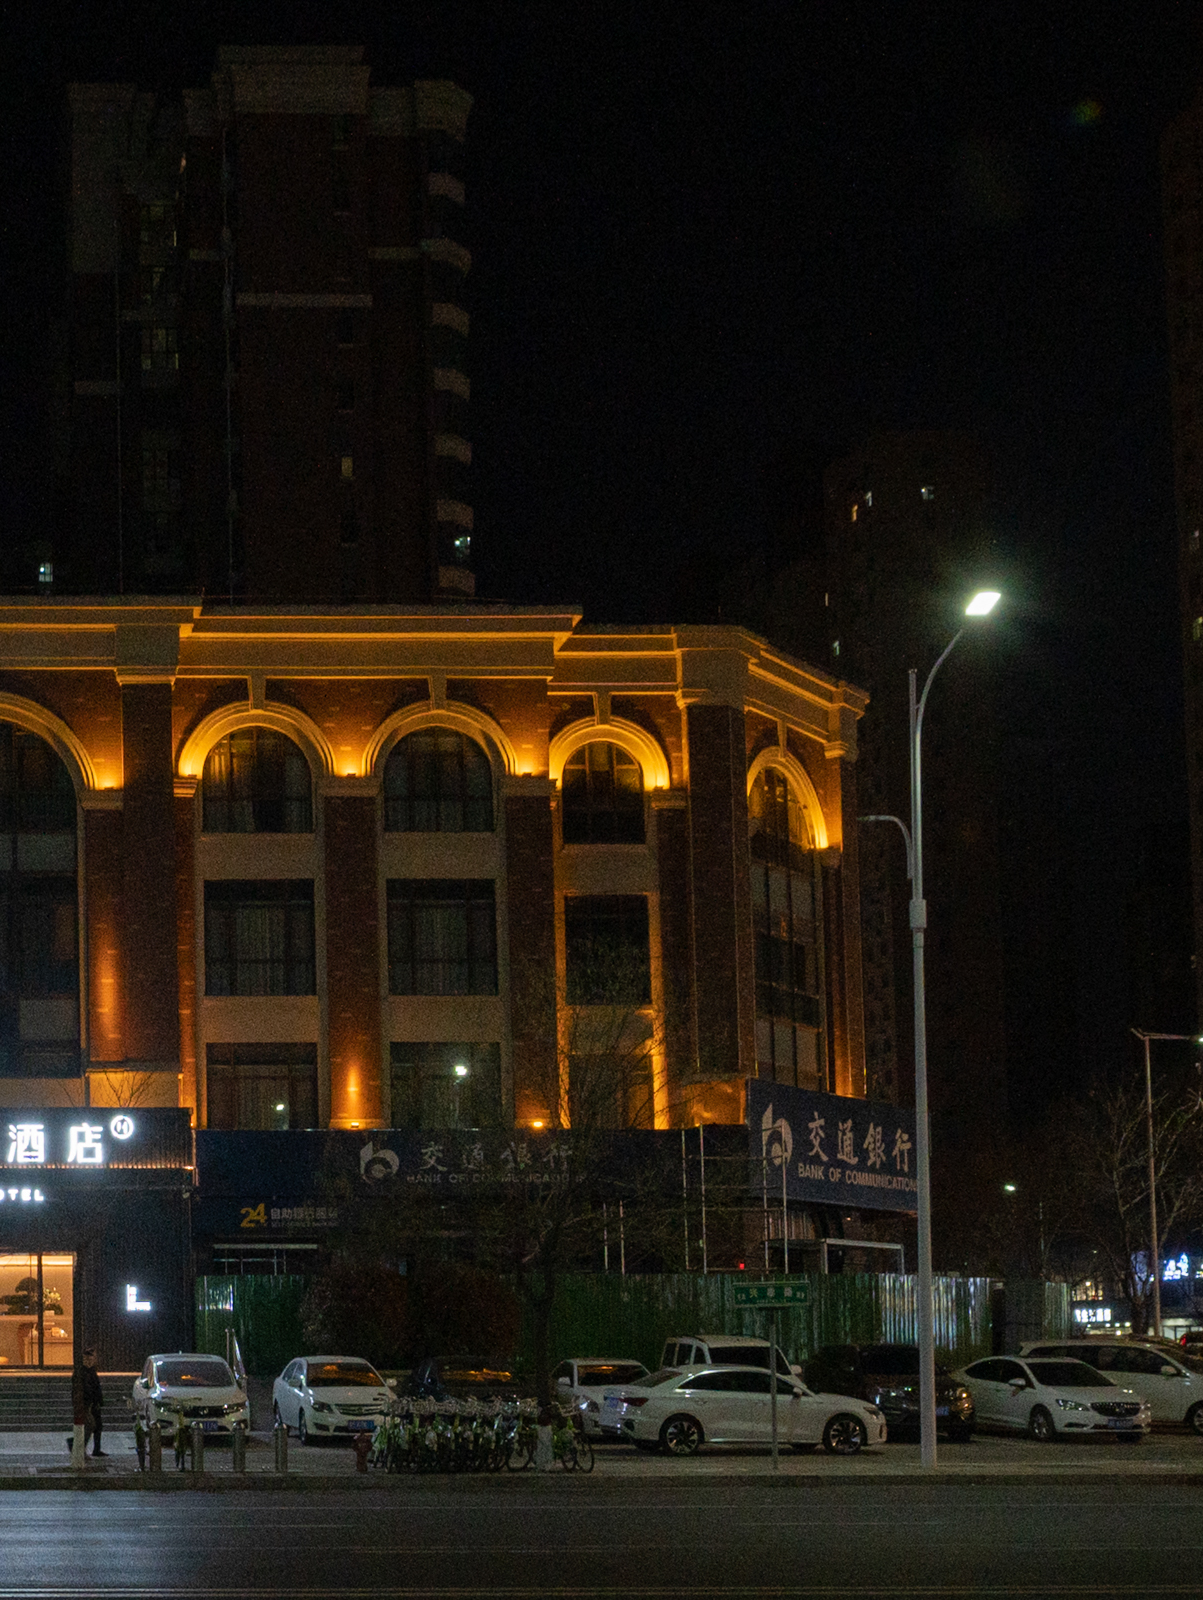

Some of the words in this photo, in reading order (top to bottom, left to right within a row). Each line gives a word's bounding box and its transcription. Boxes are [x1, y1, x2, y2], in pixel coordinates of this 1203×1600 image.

[797, 1162, 825, 1180] BANK
[828, 1166, 842, 1183] OF
[845, 1169, 917, 1193] COMMUNICATION
[240, 1202, 268, 1228] 24
